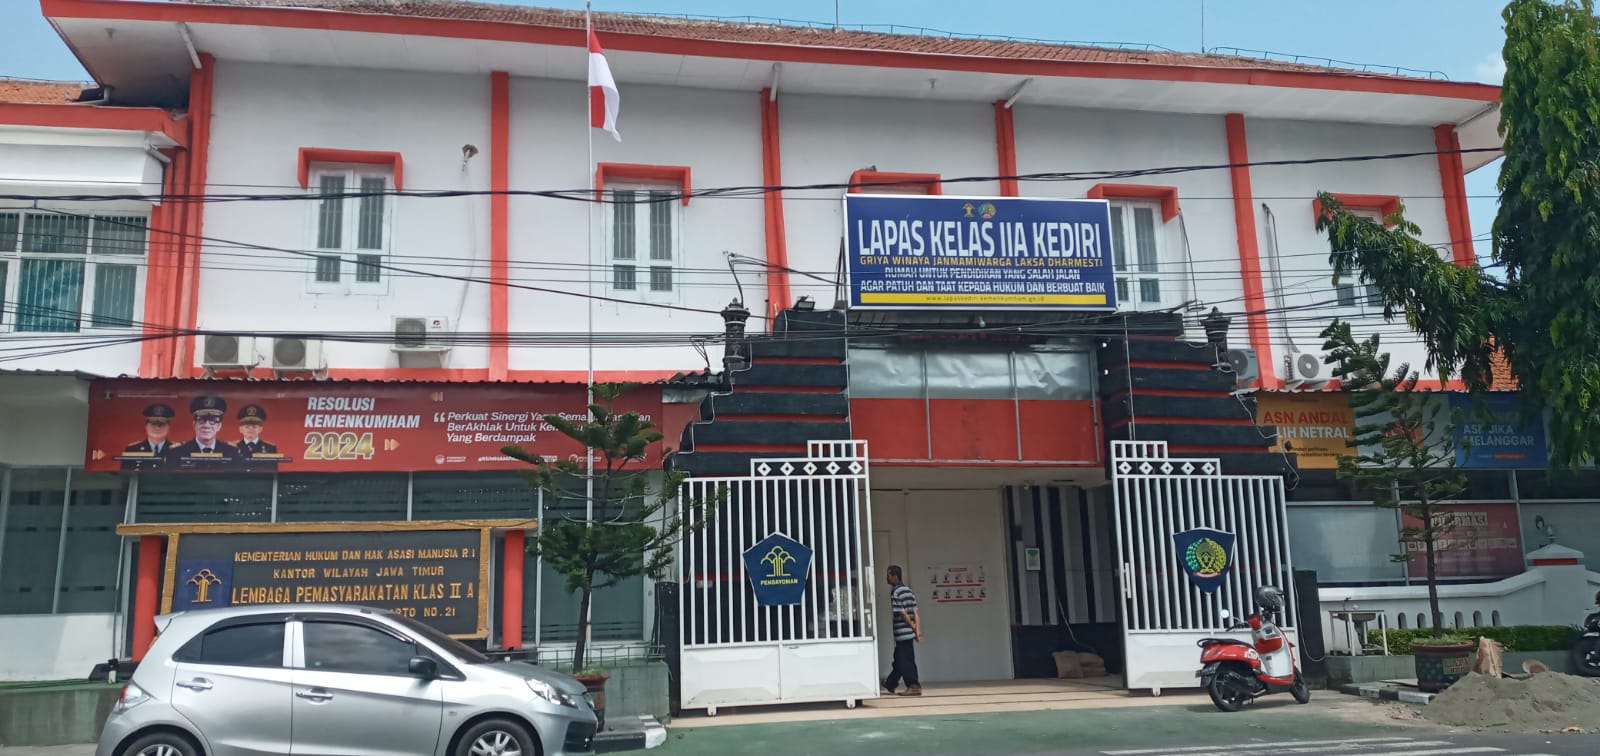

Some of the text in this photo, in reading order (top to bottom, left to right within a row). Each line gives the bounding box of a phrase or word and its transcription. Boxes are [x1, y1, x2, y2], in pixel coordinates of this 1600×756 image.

[858, 219, 1102, 258] LAPAS KELAS IIA KEDIRI
[860, 256, 1103, 267] GRIYA WINAYA JANMAMIWARGA LAKSA DHARMESTI
[885, 267, 1080, 280] RUMAH UNTUK PENDIDIKAN YANG SALAH JALAN
[860, 280, 1106, 293] AGAR PATUH DAN TAAT KEPADA HUKUM DAN BERBUAT BAIK
[307, 397, 375, 411] RESOLUSI
[304, 414, 421, 428] KEMENKUMHAM
[491, 411, 528, 423] Sinergi
[1263, 411, 1348, 425] ASN ANDAL
[447, 422, 502, 431] BerAkhlak
[505, 422, 537, 431] Untuk
[1300, 426, 1350, 438] NETRAL
[1488, 424, 1514, 435] JIKA
[446, 433, 536, 444] Yang Berdampak
[303, 431, 375, 460] 2024
[234, 551, 301, 562] KEMENTERIAN
[305, 550, 338, 561] HUKUM
[342, 550, 361, 560] DAN
[364, 550, 383, 560] HAK
[387, 549, 414, 559] ASASI
[418, 548, 458, 558] MANUSIA
[273, 566, 444, 578] KANTOR WILAYAH JAWA TIMUR
[231, 582, 474, 604] LEMBAGA PEMASYARAKATAN KLAS II A
